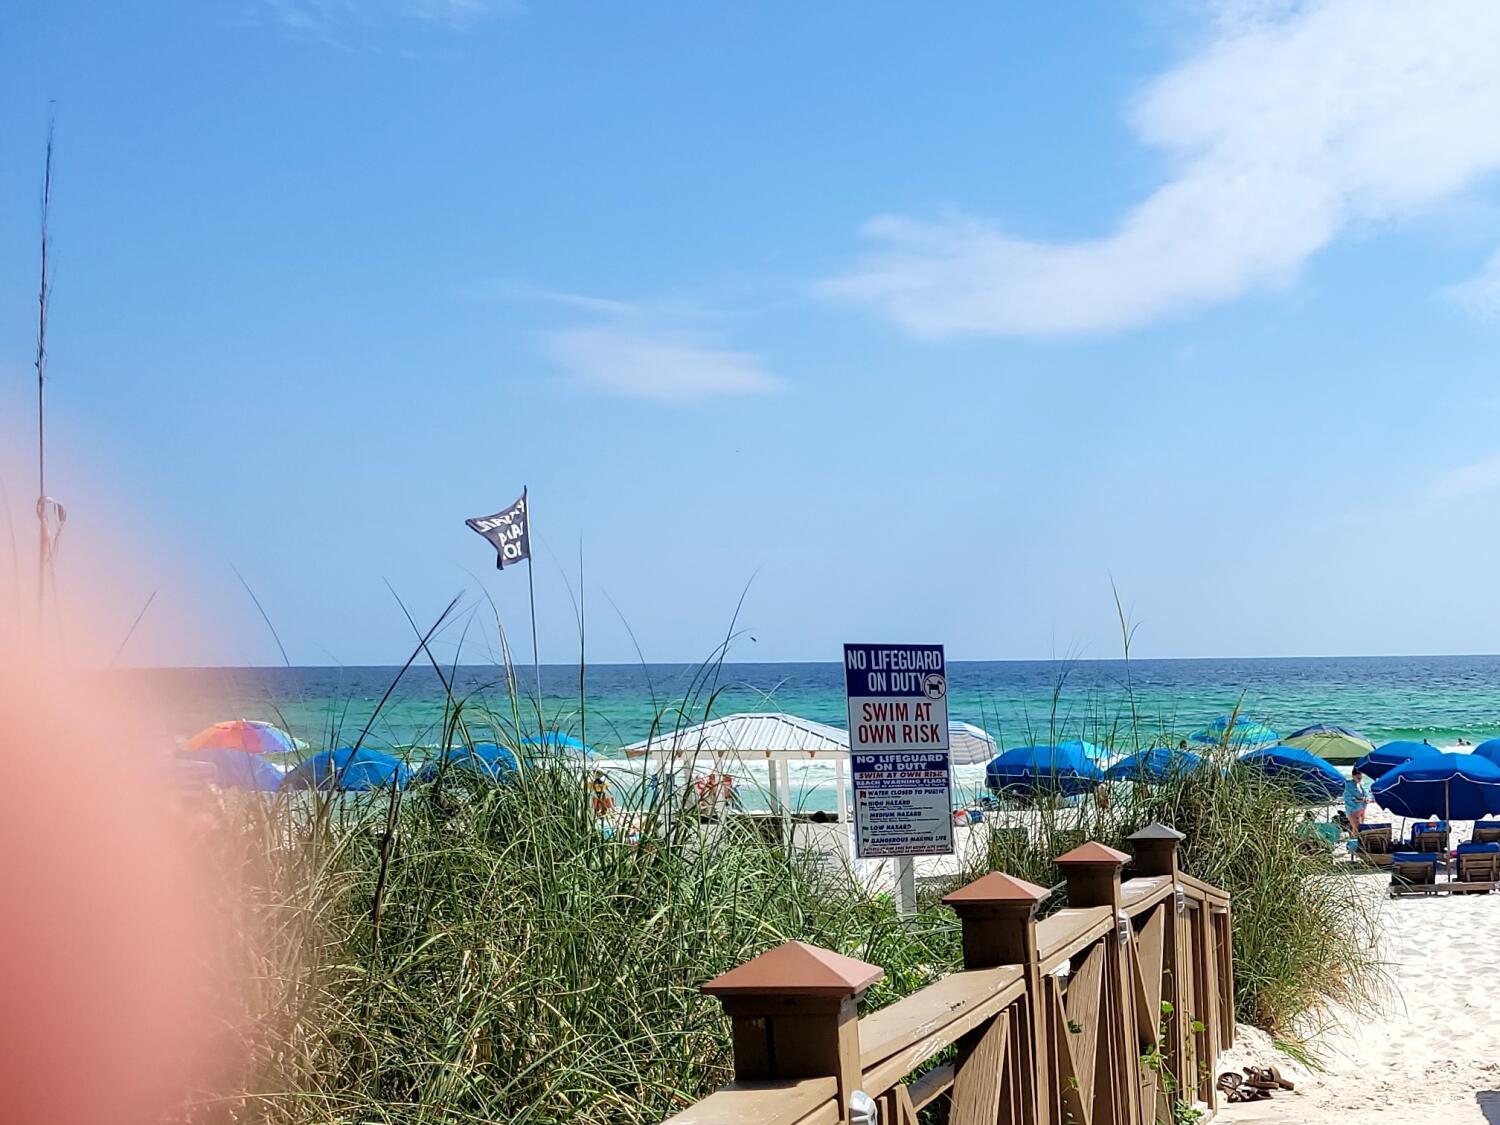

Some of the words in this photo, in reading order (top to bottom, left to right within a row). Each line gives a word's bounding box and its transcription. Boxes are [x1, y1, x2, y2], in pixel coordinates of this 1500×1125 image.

[847, 650, 867, 670] NO
[870, 650, 941, 670] LIFEGUARD
[867, 672, 887, 692] ON
[891, 672, 925, 692] DUTY
[862, 703, 909, 722] SWIM
[914, 703, 932, 721] AT
[858, 724, 896, 744] OWN
[902, 723, 940, 743] RISK
[856, 755, 875, 763] NO
[879, 754, 943, 763] LIFEGUARD
[874, 763, 892, 771] ON
[897, 763, 927, 771] DUTY
